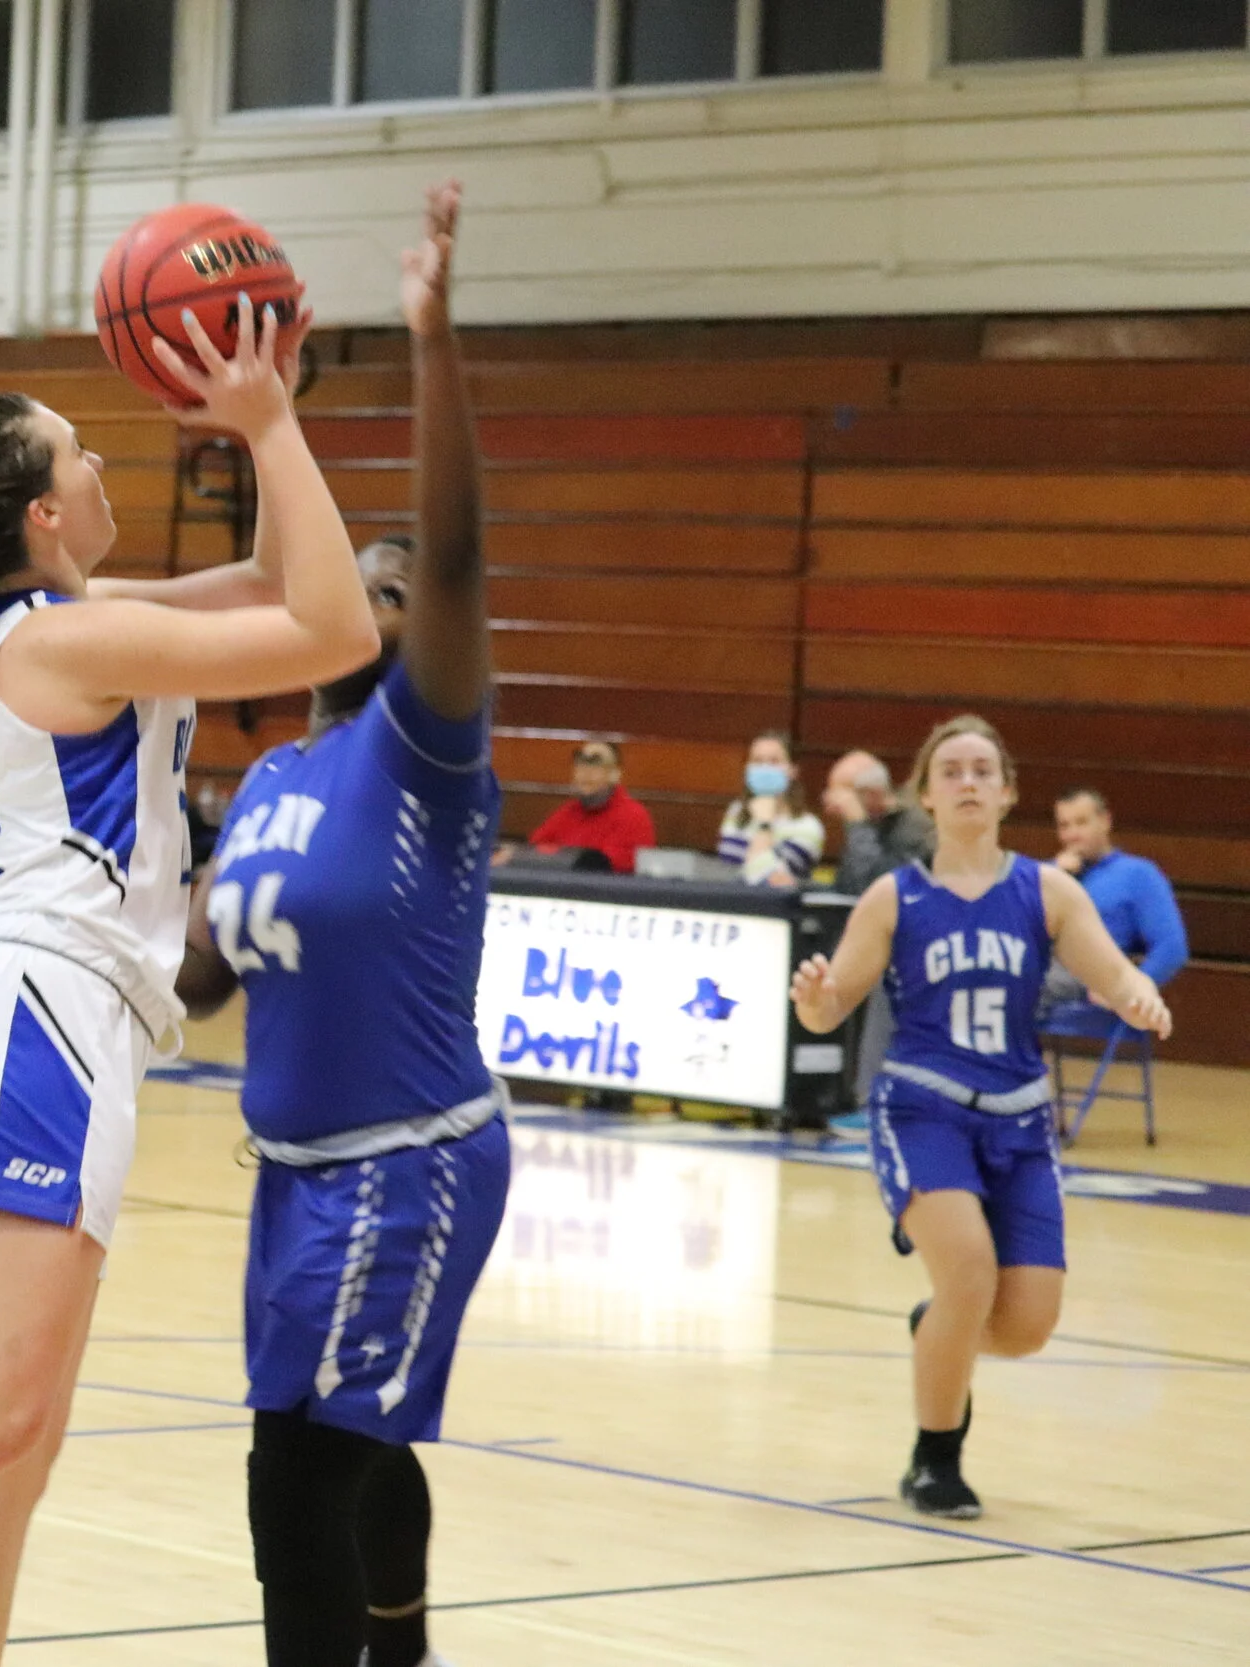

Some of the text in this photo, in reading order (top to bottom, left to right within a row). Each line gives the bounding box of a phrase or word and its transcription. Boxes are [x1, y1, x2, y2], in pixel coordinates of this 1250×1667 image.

[486, 902, 532, 929] ON
[522, 947, 623, 1006] Blue
[925, 927, 1026, 984] CLAY
[498, 1013, 640, 1080] Devils
[951, 986, 1007, 1055] 15
[3, 1156, 67, 1188] SCP
